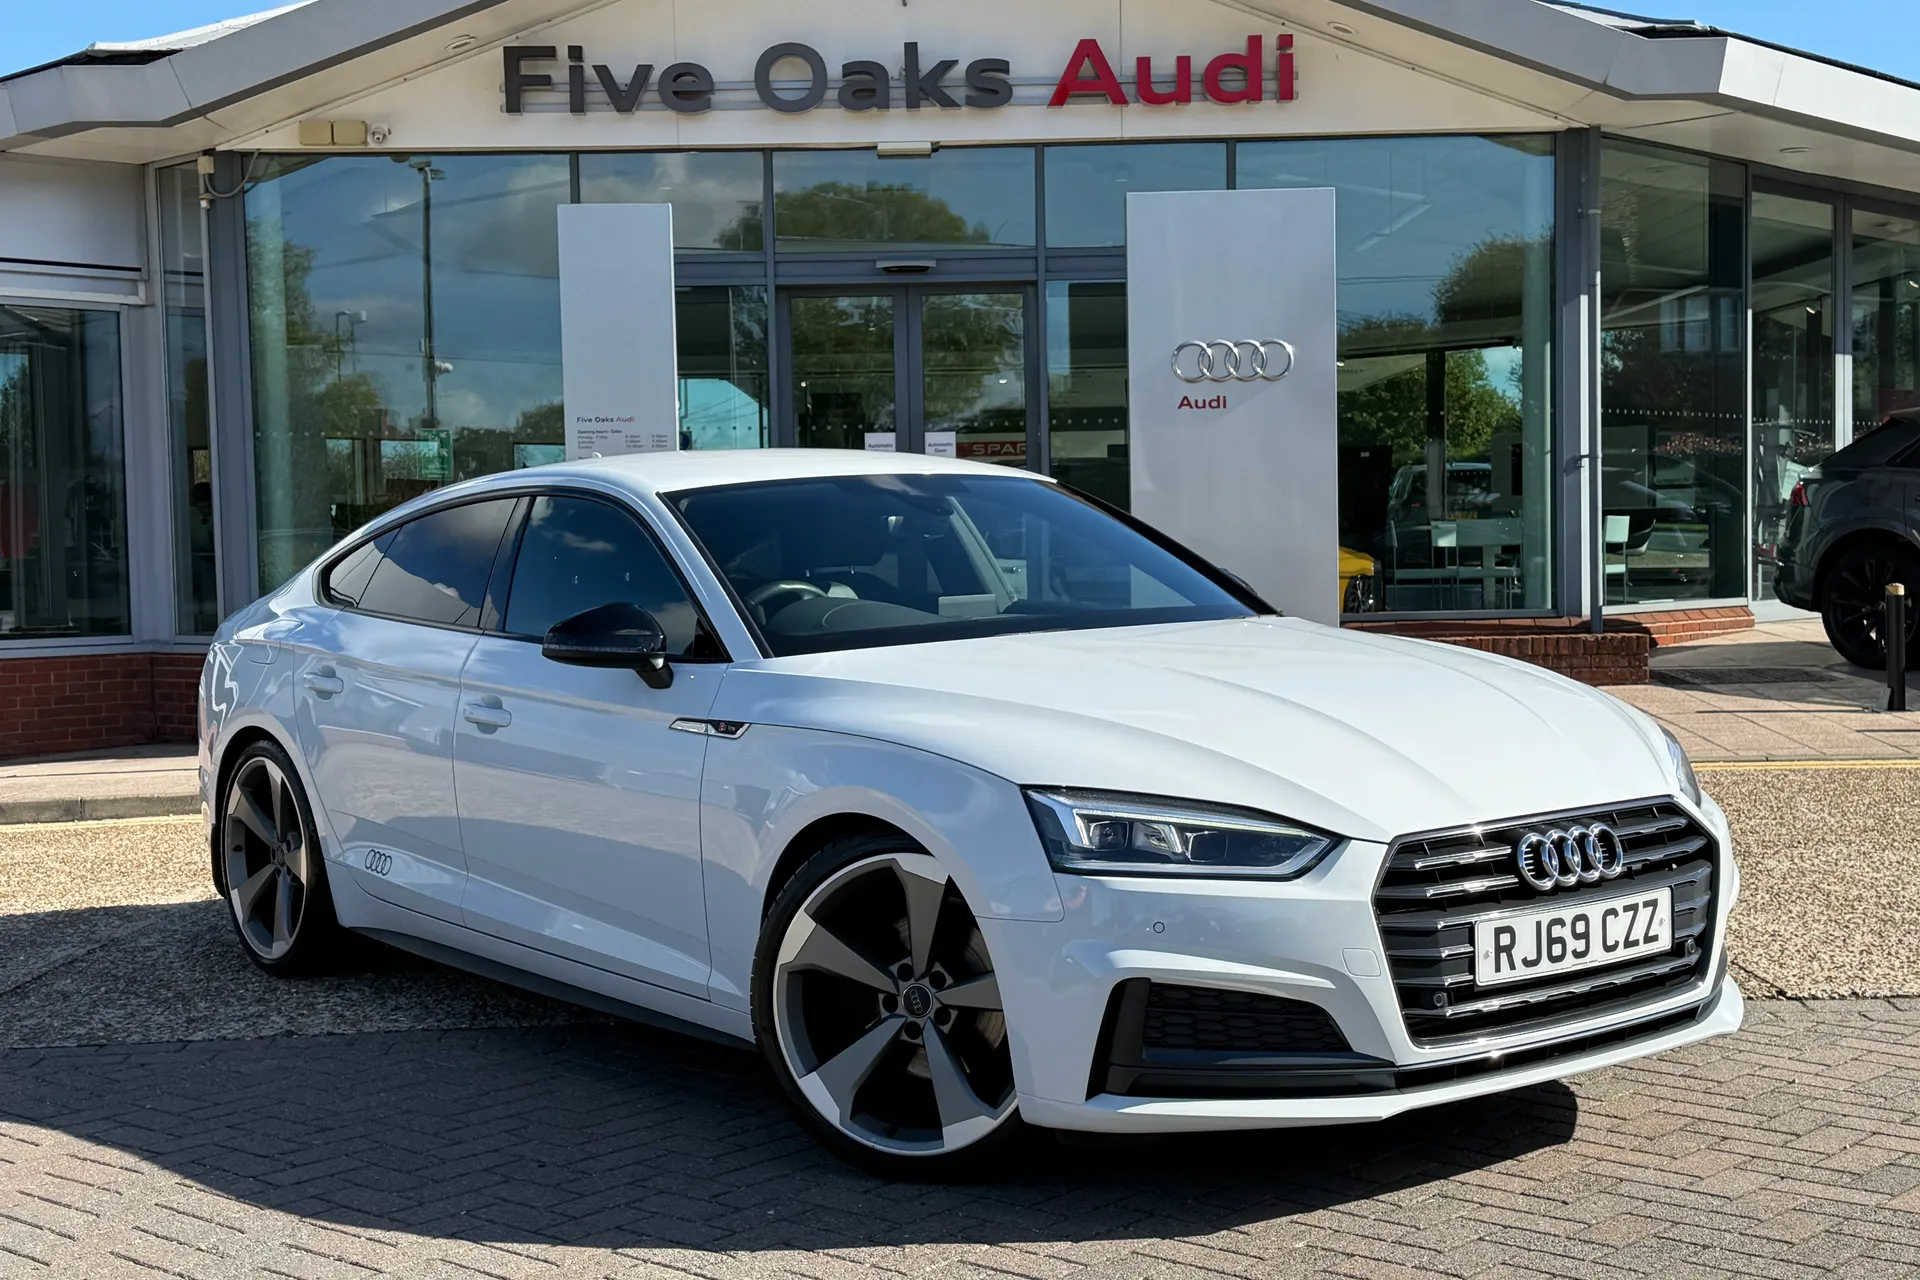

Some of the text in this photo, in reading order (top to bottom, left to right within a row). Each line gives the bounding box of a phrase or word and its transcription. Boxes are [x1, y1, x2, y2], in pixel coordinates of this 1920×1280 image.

[503, 34, 1294, 115] Five Oaks Audi
[1178, 395, 1227, 409] Audi
[1494, 898, 1659, 973] RJ69 CZZ
